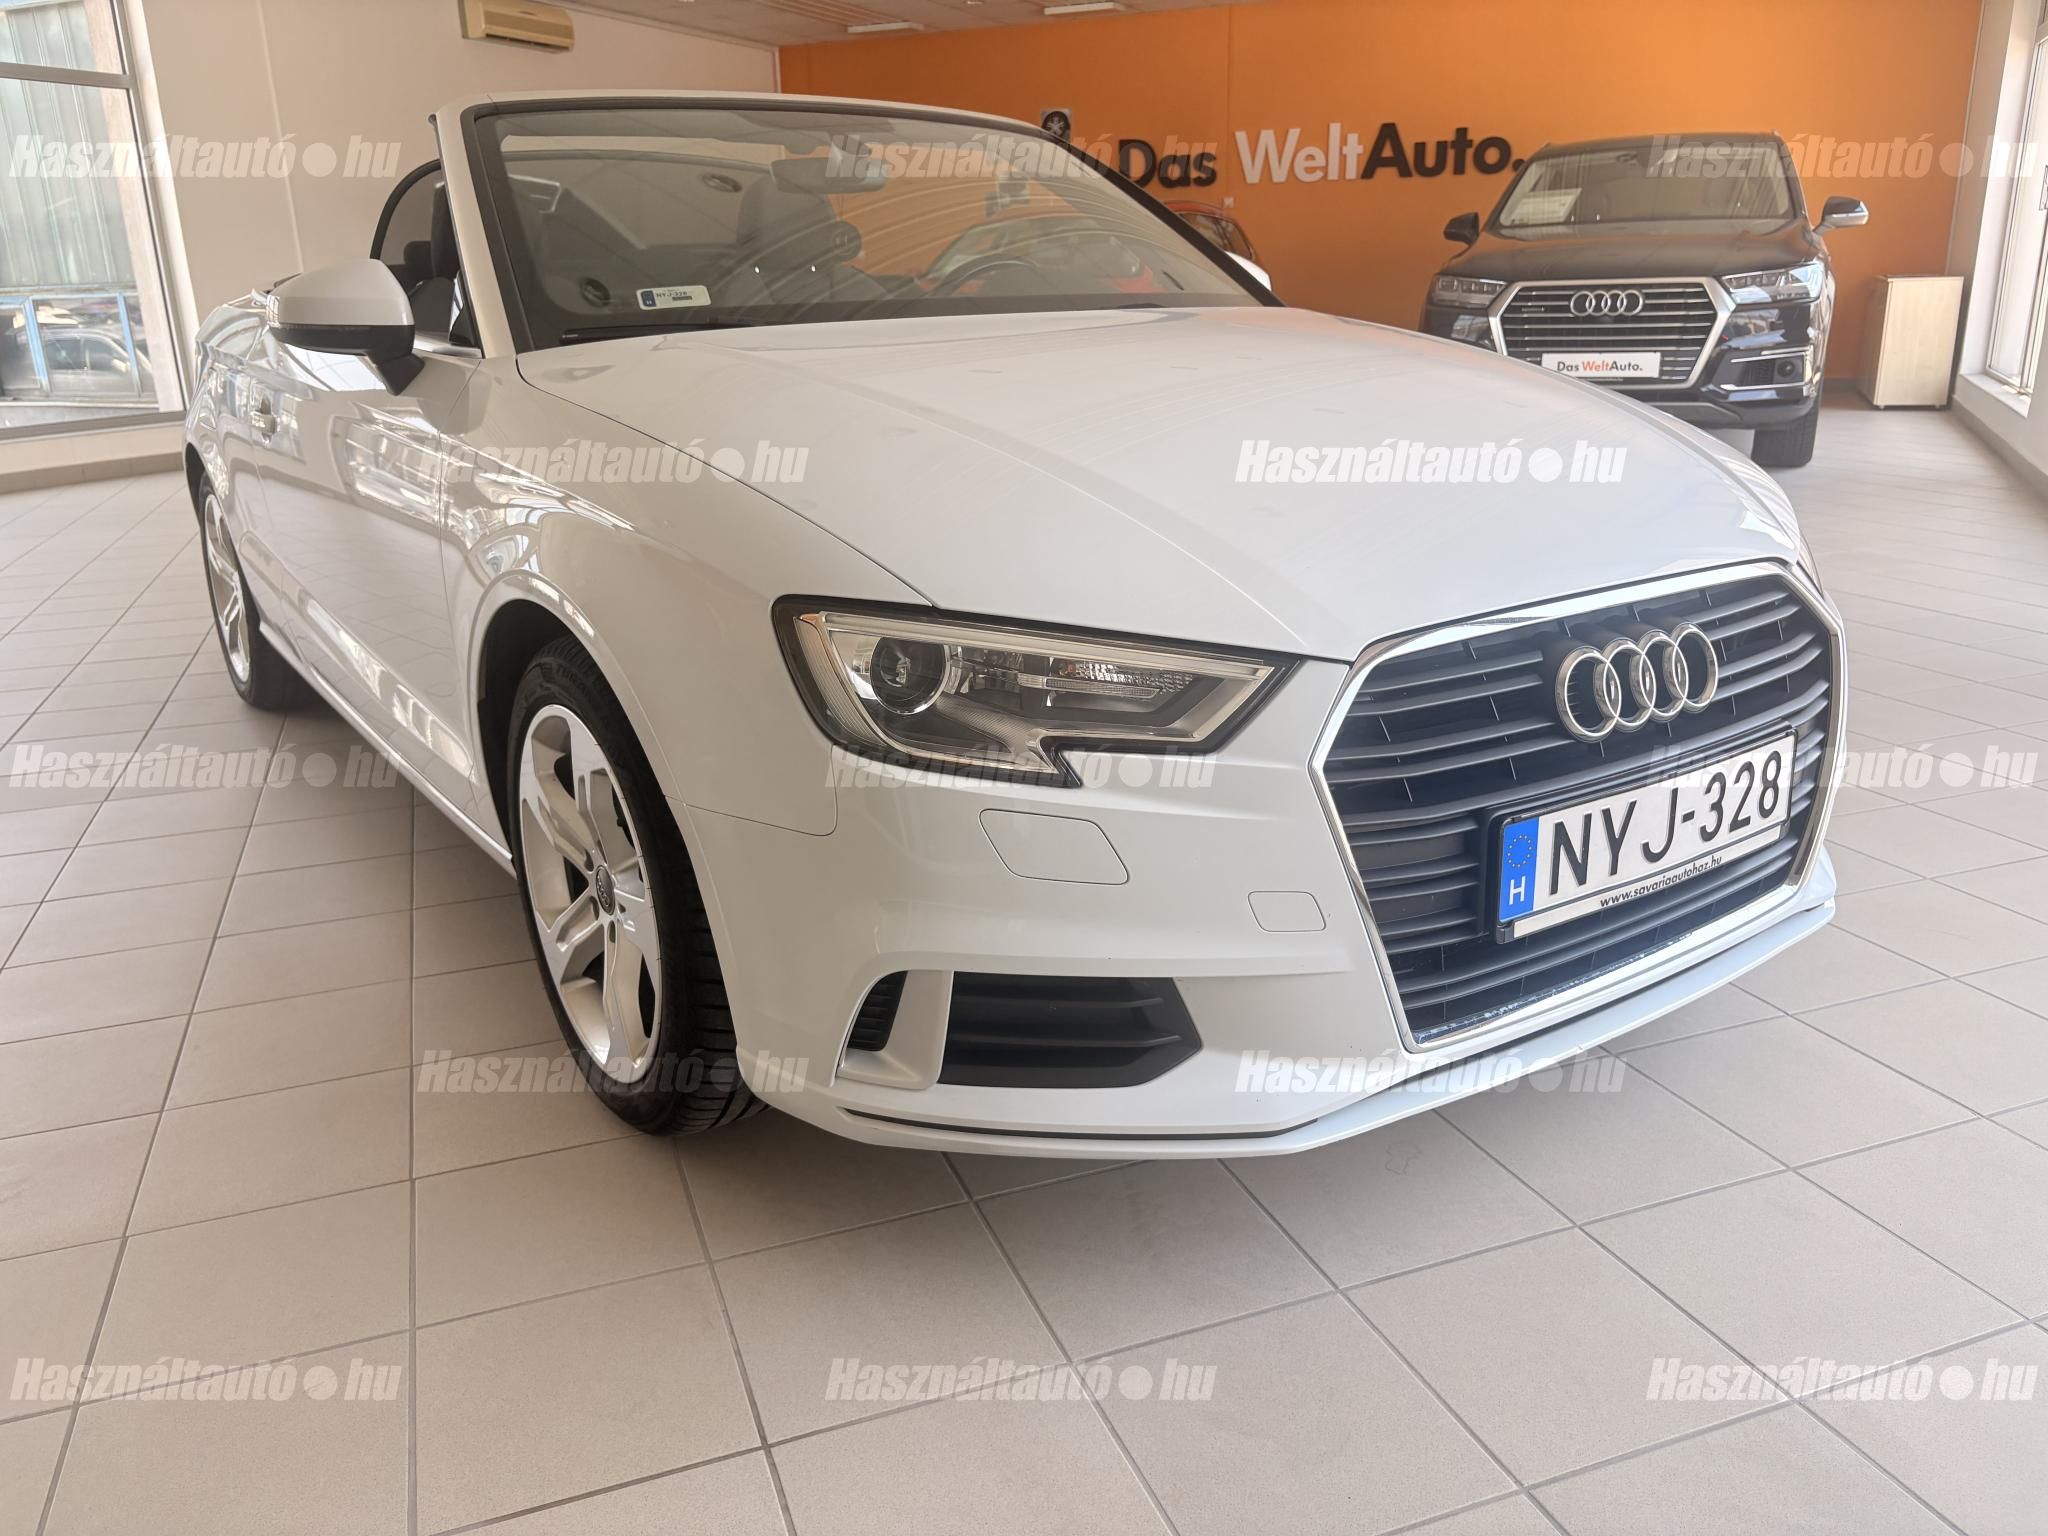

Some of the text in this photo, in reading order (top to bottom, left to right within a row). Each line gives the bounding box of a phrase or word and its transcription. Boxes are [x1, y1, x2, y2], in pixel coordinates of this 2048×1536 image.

[1118, 121, 1526, 189] Das WeltAuto.
[1556, 360, 1643, 372] Das WeltAuto.
[1549, 750, 1782, 896] NYJ-328
[1508, 875, 1526, 905] H
[1599, 854, 1723, 908] www.savariaautohaz.hu
